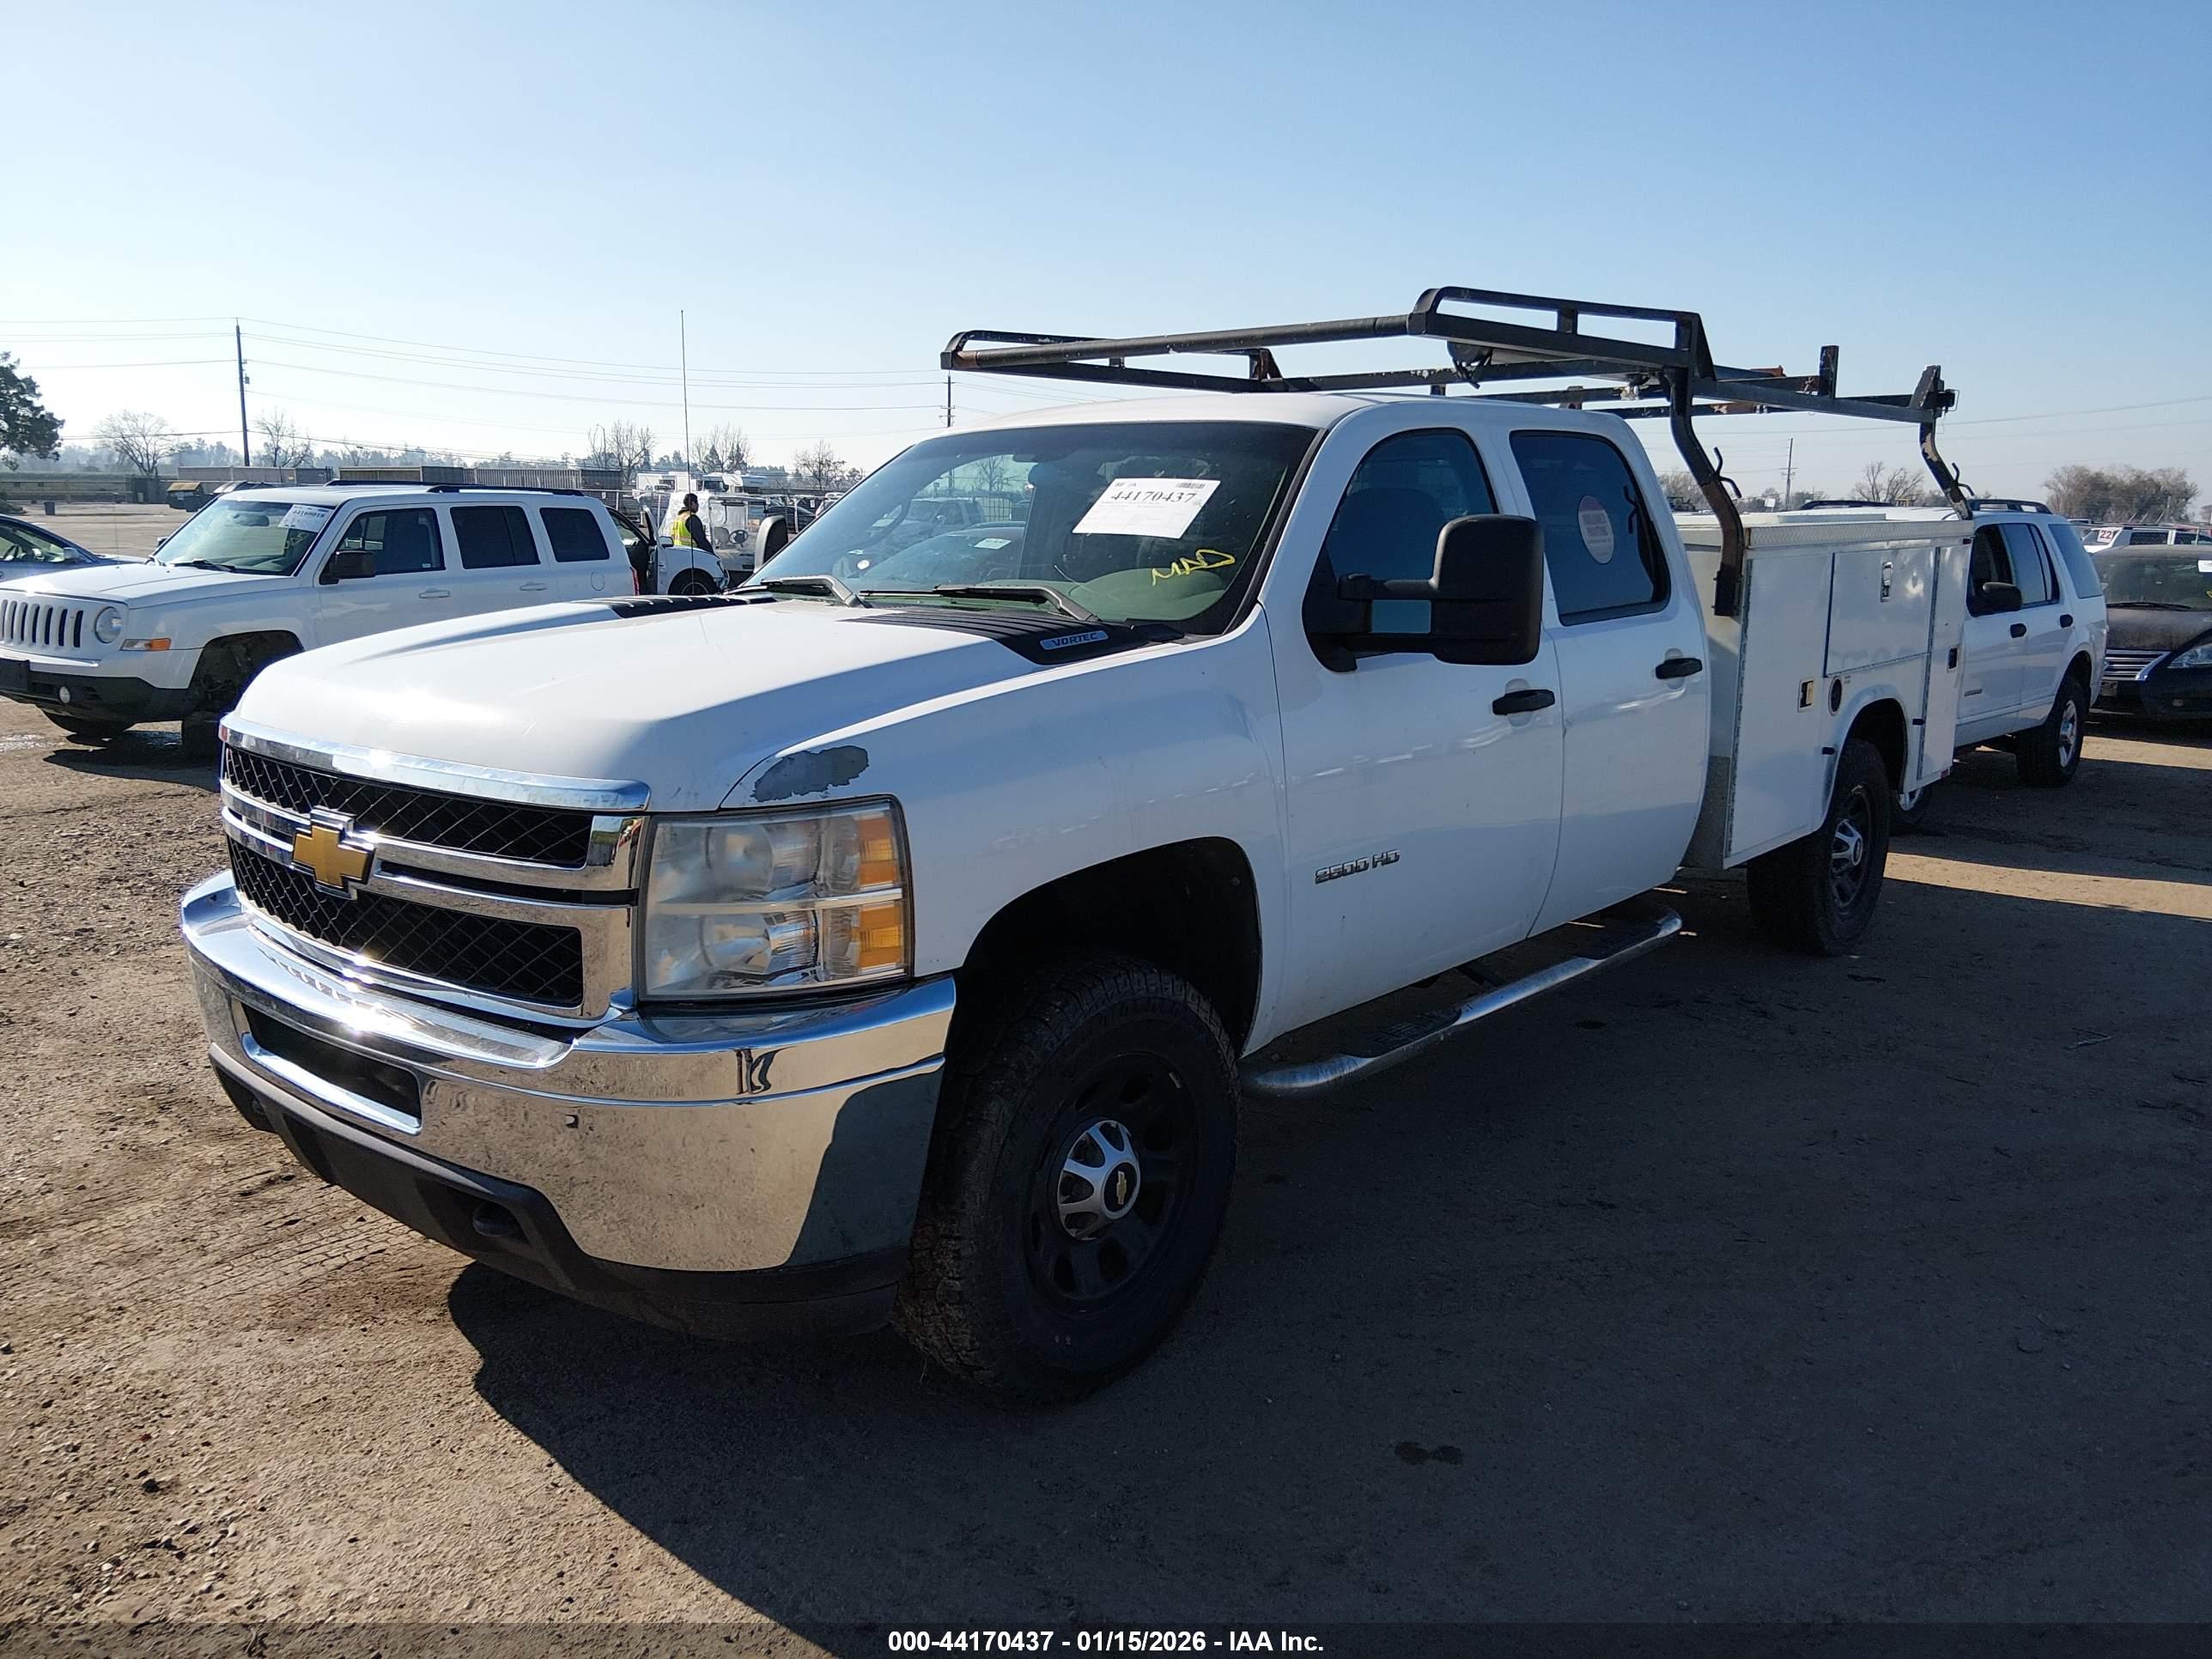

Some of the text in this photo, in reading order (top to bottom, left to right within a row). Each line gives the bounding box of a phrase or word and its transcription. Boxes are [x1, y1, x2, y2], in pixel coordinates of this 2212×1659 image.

[1111, 490, 1197, 503] 44170437
[2100, 530, 2112, 539] 22
[1051, 632, 1098, 647] VORTEC
[1315, 848, 1401, 884] 2500 HD
